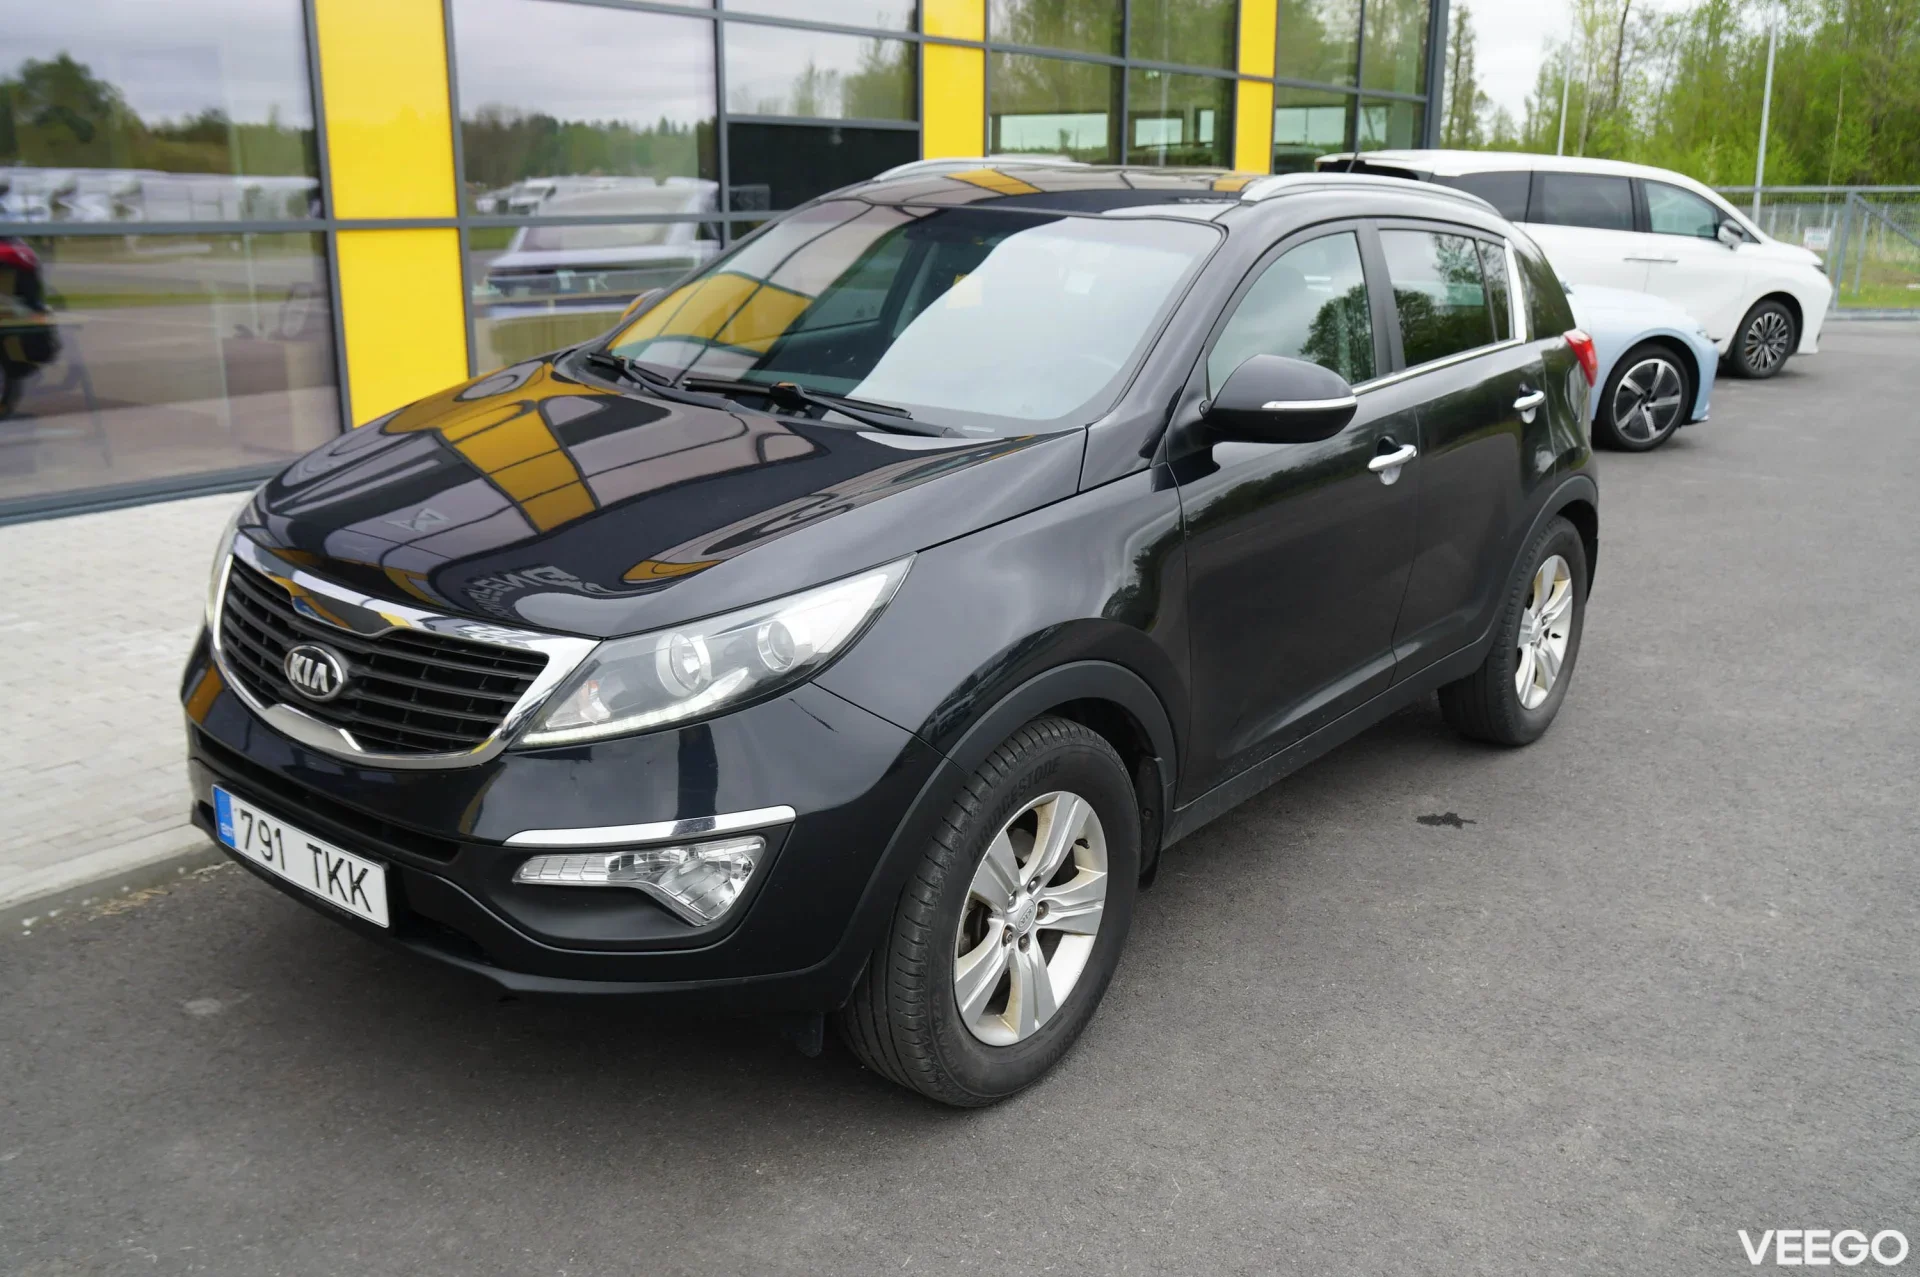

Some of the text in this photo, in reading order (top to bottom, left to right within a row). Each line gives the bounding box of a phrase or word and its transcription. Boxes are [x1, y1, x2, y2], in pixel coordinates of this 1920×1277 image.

[288, 653, 328, 692] KIA
[240, 809, 372, 913] 791 TKK
